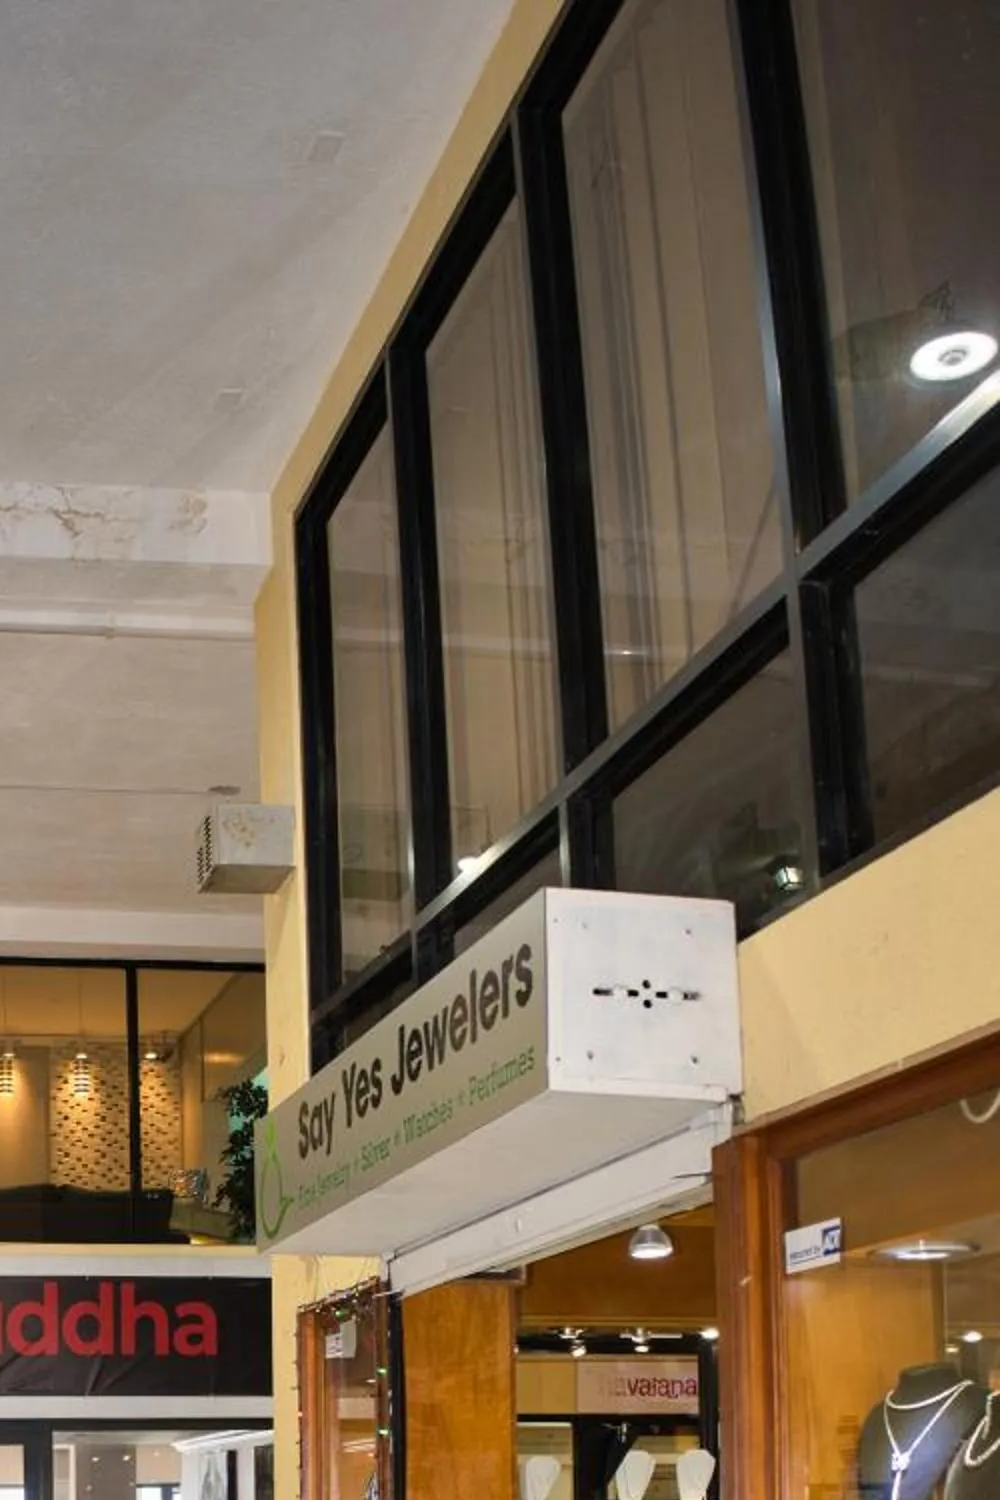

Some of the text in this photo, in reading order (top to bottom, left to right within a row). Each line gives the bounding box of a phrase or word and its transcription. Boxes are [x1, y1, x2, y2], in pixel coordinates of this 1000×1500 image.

[297, 943, 533, 1159] Say Yes Jewelers
[403, 1099, 454, 1145] Watches
[469, 1047, 535, 1106] Perfumes
